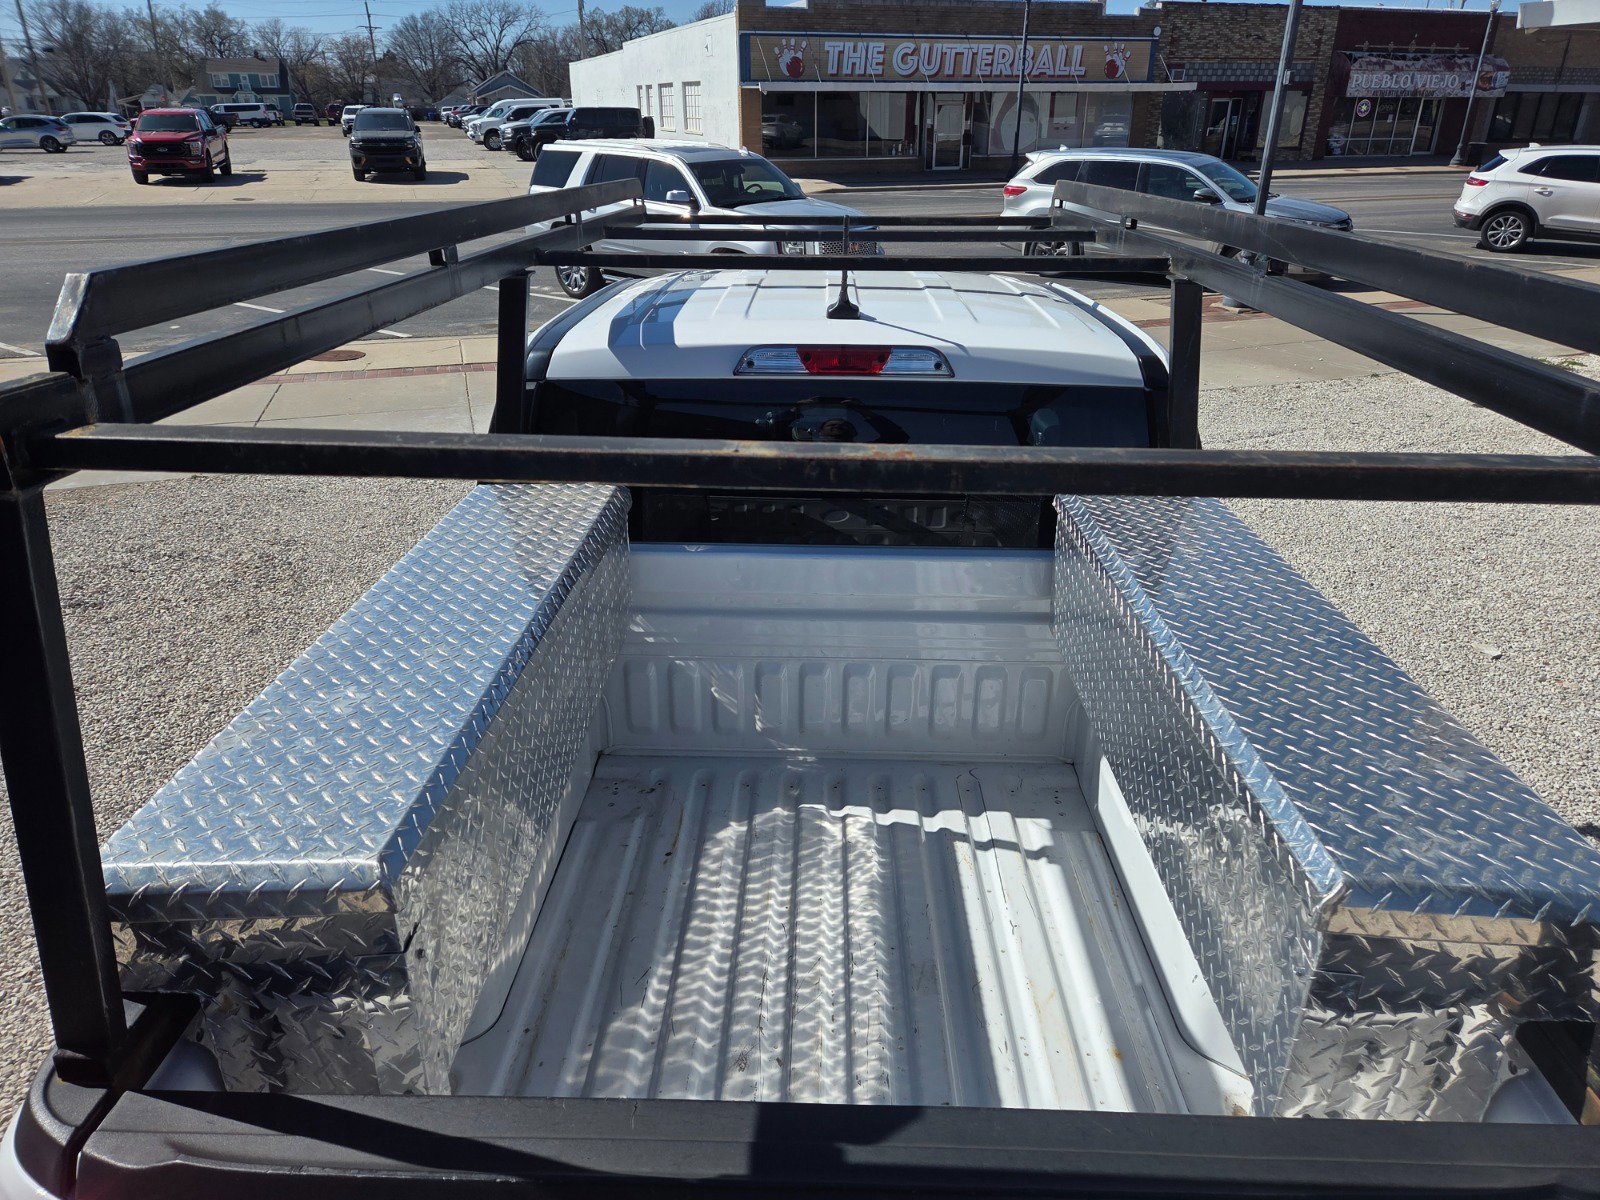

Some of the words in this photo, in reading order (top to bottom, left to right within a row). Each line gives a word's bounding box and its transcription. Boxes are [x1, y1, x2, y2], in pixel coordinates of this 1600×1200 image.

[824, 41, 886, 76] THE
[892, 42, 1087, 78] GUTTERBALL
[1350, 73, 1412, 89] PUEBLO
[1416, 73, 1460, 88] VIEJO
